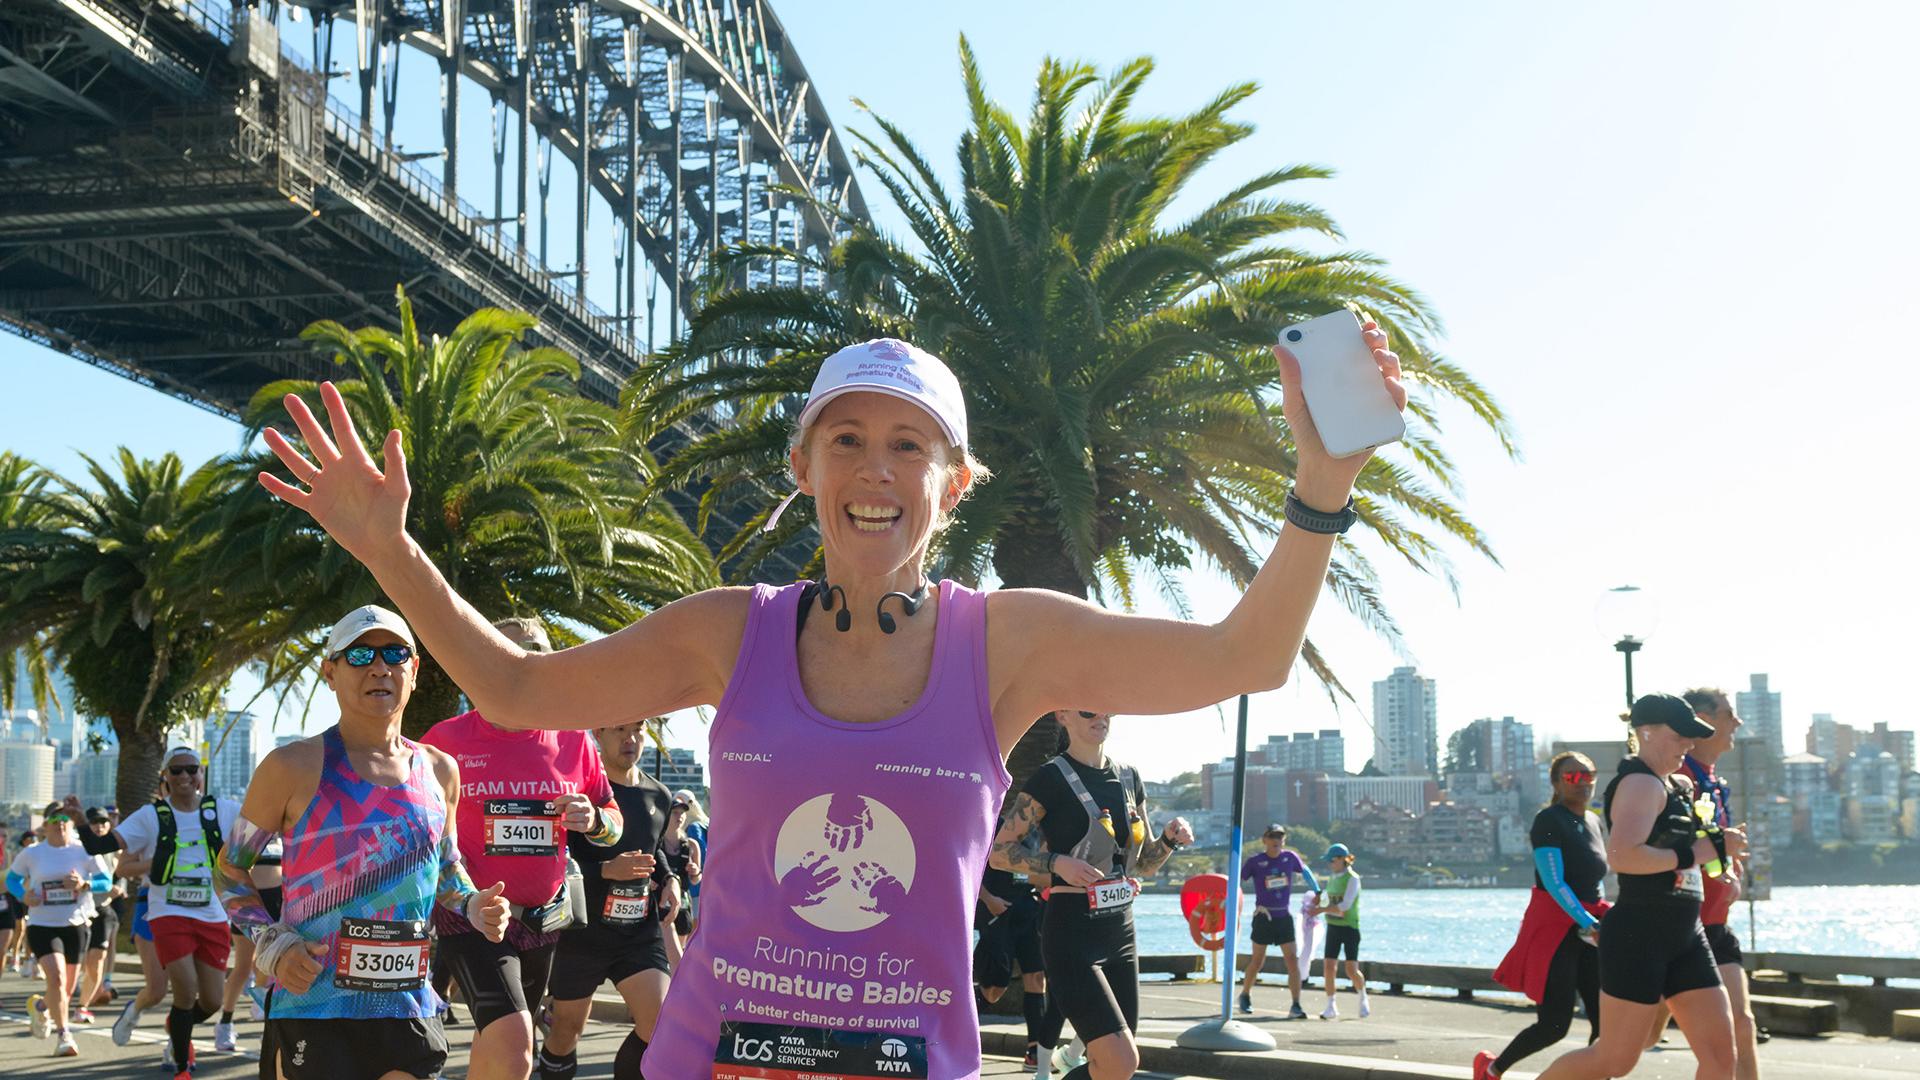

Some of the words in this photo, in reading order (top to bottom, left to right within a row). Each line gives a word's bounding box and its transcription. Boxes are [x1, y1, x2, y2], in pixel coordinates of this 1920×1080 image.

[722, 752, 769, 762] PENDAL
[875, 763, 931, 777] running
[936, 766, 966, 779] bare
[460, 781, 504, 797] TEAM
[509, 781, 578, 797] VITALITY
[490, 803, 507, 814] tcs
[503, 826, 544, 840] 34101
[615, 904, 643, 914] 35264
[349, 925, 370, 938] tcs
[355, 952, 415, 972] 33064
[421, 958, 427, 966] A
[754, 936, 867, 978] Running
[878, 952, 914, 976] for
[712, 957, 853, 1003] Premature
[863, 981, 952, 1006] Babies
[734, 999, 745, 1011] A
[749, 1001, 789, 1020] better
[793, 1011, 844, 1027] chance
[849, 1015, 863, 1028] of
[867, 1016, 919, 1029] survival
[733, 1032, 773, 1061] tcs
[780, 1036, 805, 1045] TATA
[778, 1045, 839, 1058] CONSULTANCY
[776, 1055, 816, 1066] SERVICES
[875, 1060, 911, 1073] TATA
